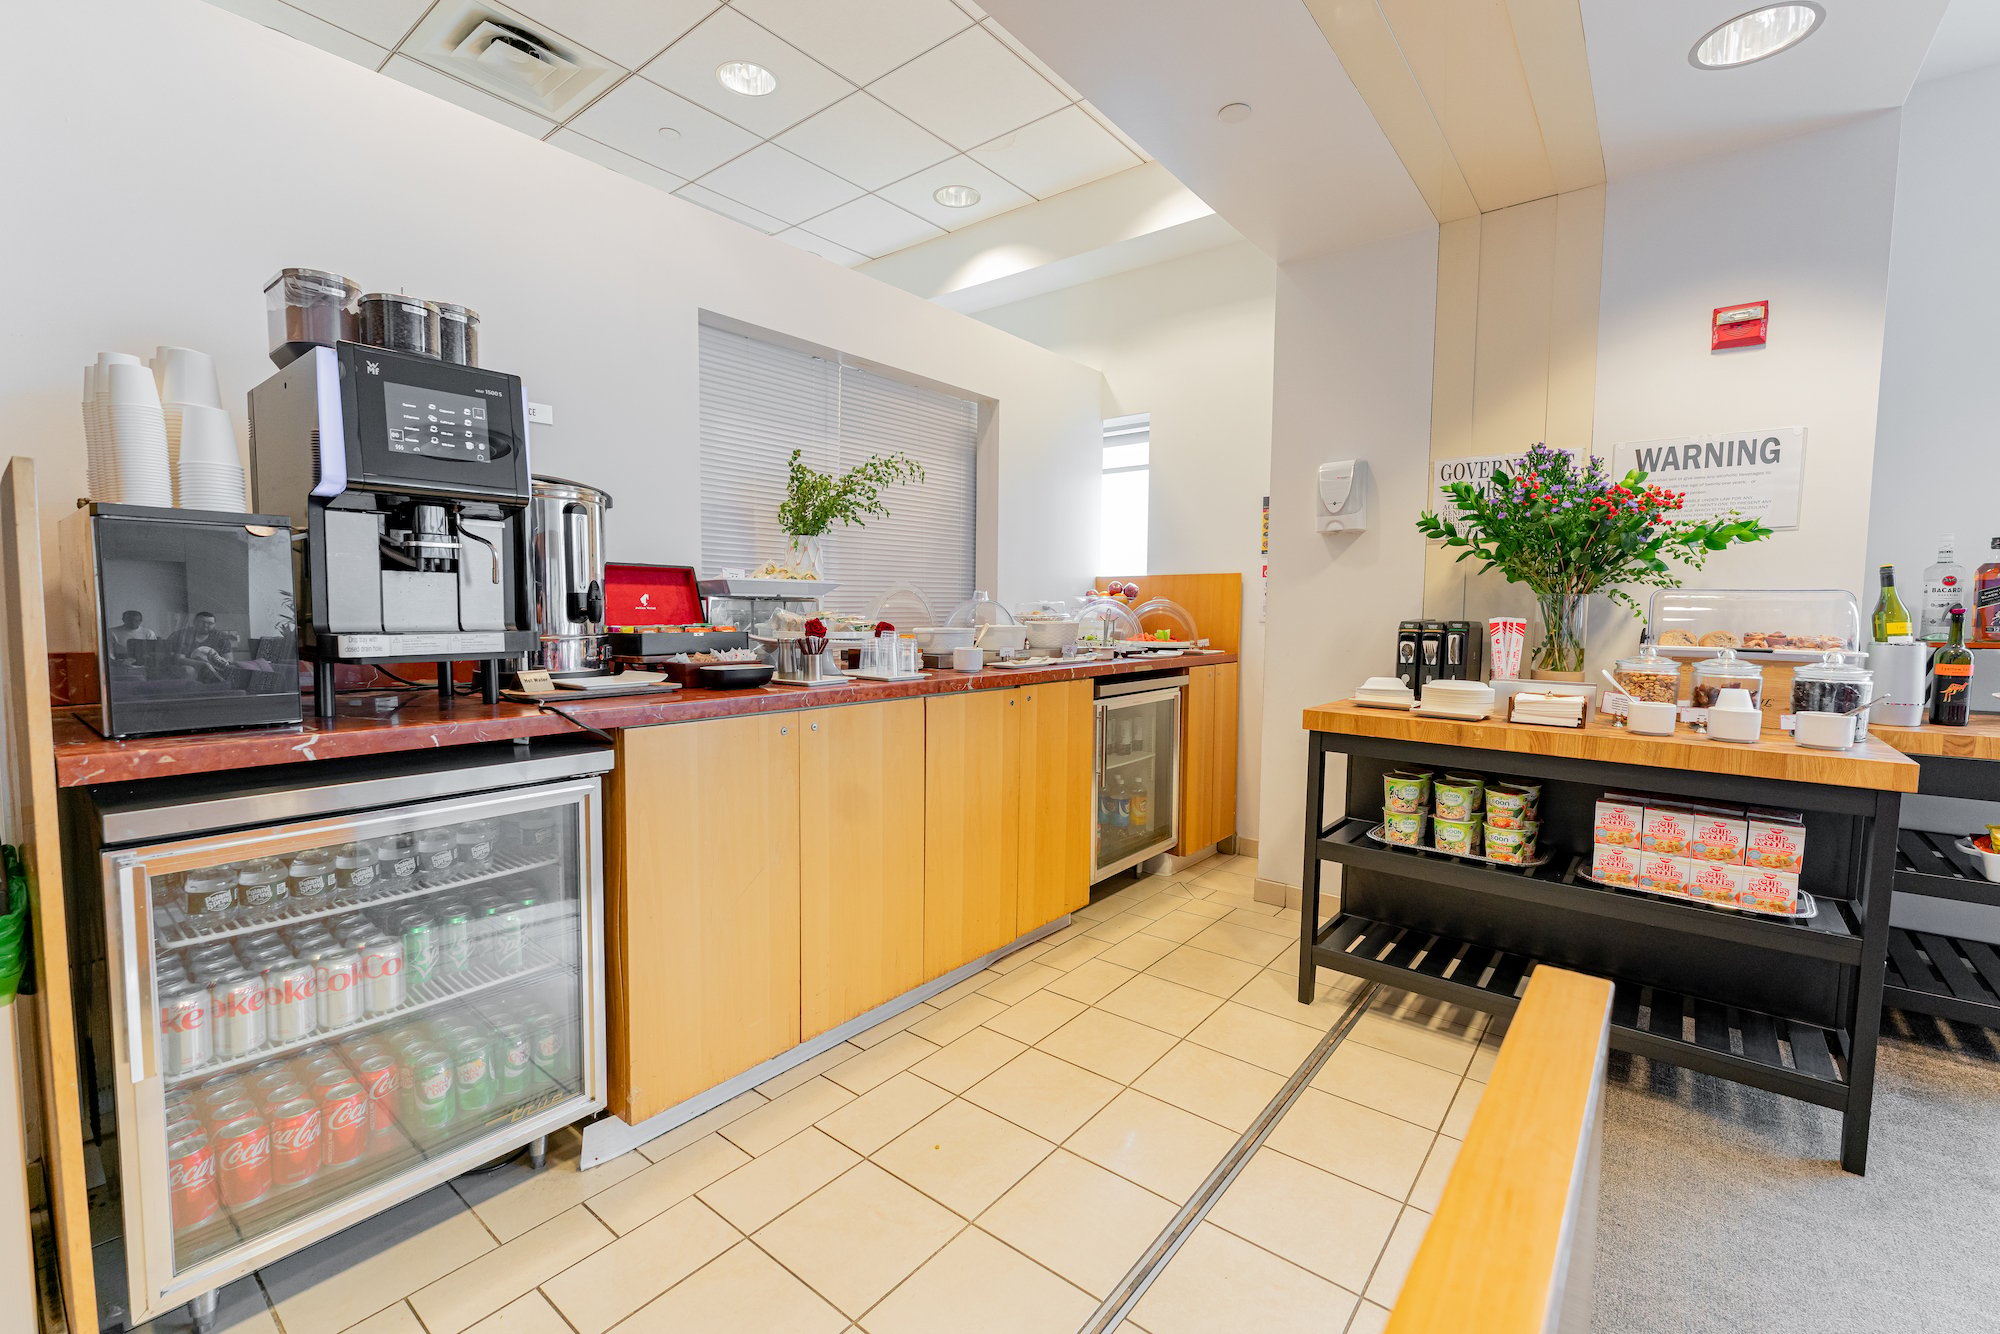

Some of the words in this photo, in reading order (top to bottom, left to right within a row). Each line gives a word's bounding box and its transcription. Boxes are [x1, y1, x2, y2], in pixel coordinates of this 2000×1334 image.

[485, 389, 498, 398] 1500
[1635, 436, 1781, 472] WARNING
[1600, 818, 1636, 828] NOODLES
[1658, 820, 1679, 829] CUP
[1649, 825, 1686, 837] NOODLES
[1709, 827, 1732, 836] CUP
[1699, 832, 1738, 844] NOODLES
[1765, 834, 1788, 842] CUP
[1754, 838, 1796, 851] NOODLES
[1607, 854, 1628, 862] CUP
[1599, 859, 1634, 870] NOODLES
[1655, 862, 1676, 872] CUP
[1646, 866, 1683, 879] NOODLES
[1705, 871, 1728, 880] CUP
[298, 876, 323, 888] Poland
[1696, 875, 1735, 888] NOODLES
[1759, 879, 1782, 887] CUP
[246, 886, 272, 897] Poland
[300, 882, 324, 895] Spring
[1748, 883, 1790, 896] NOODLES
